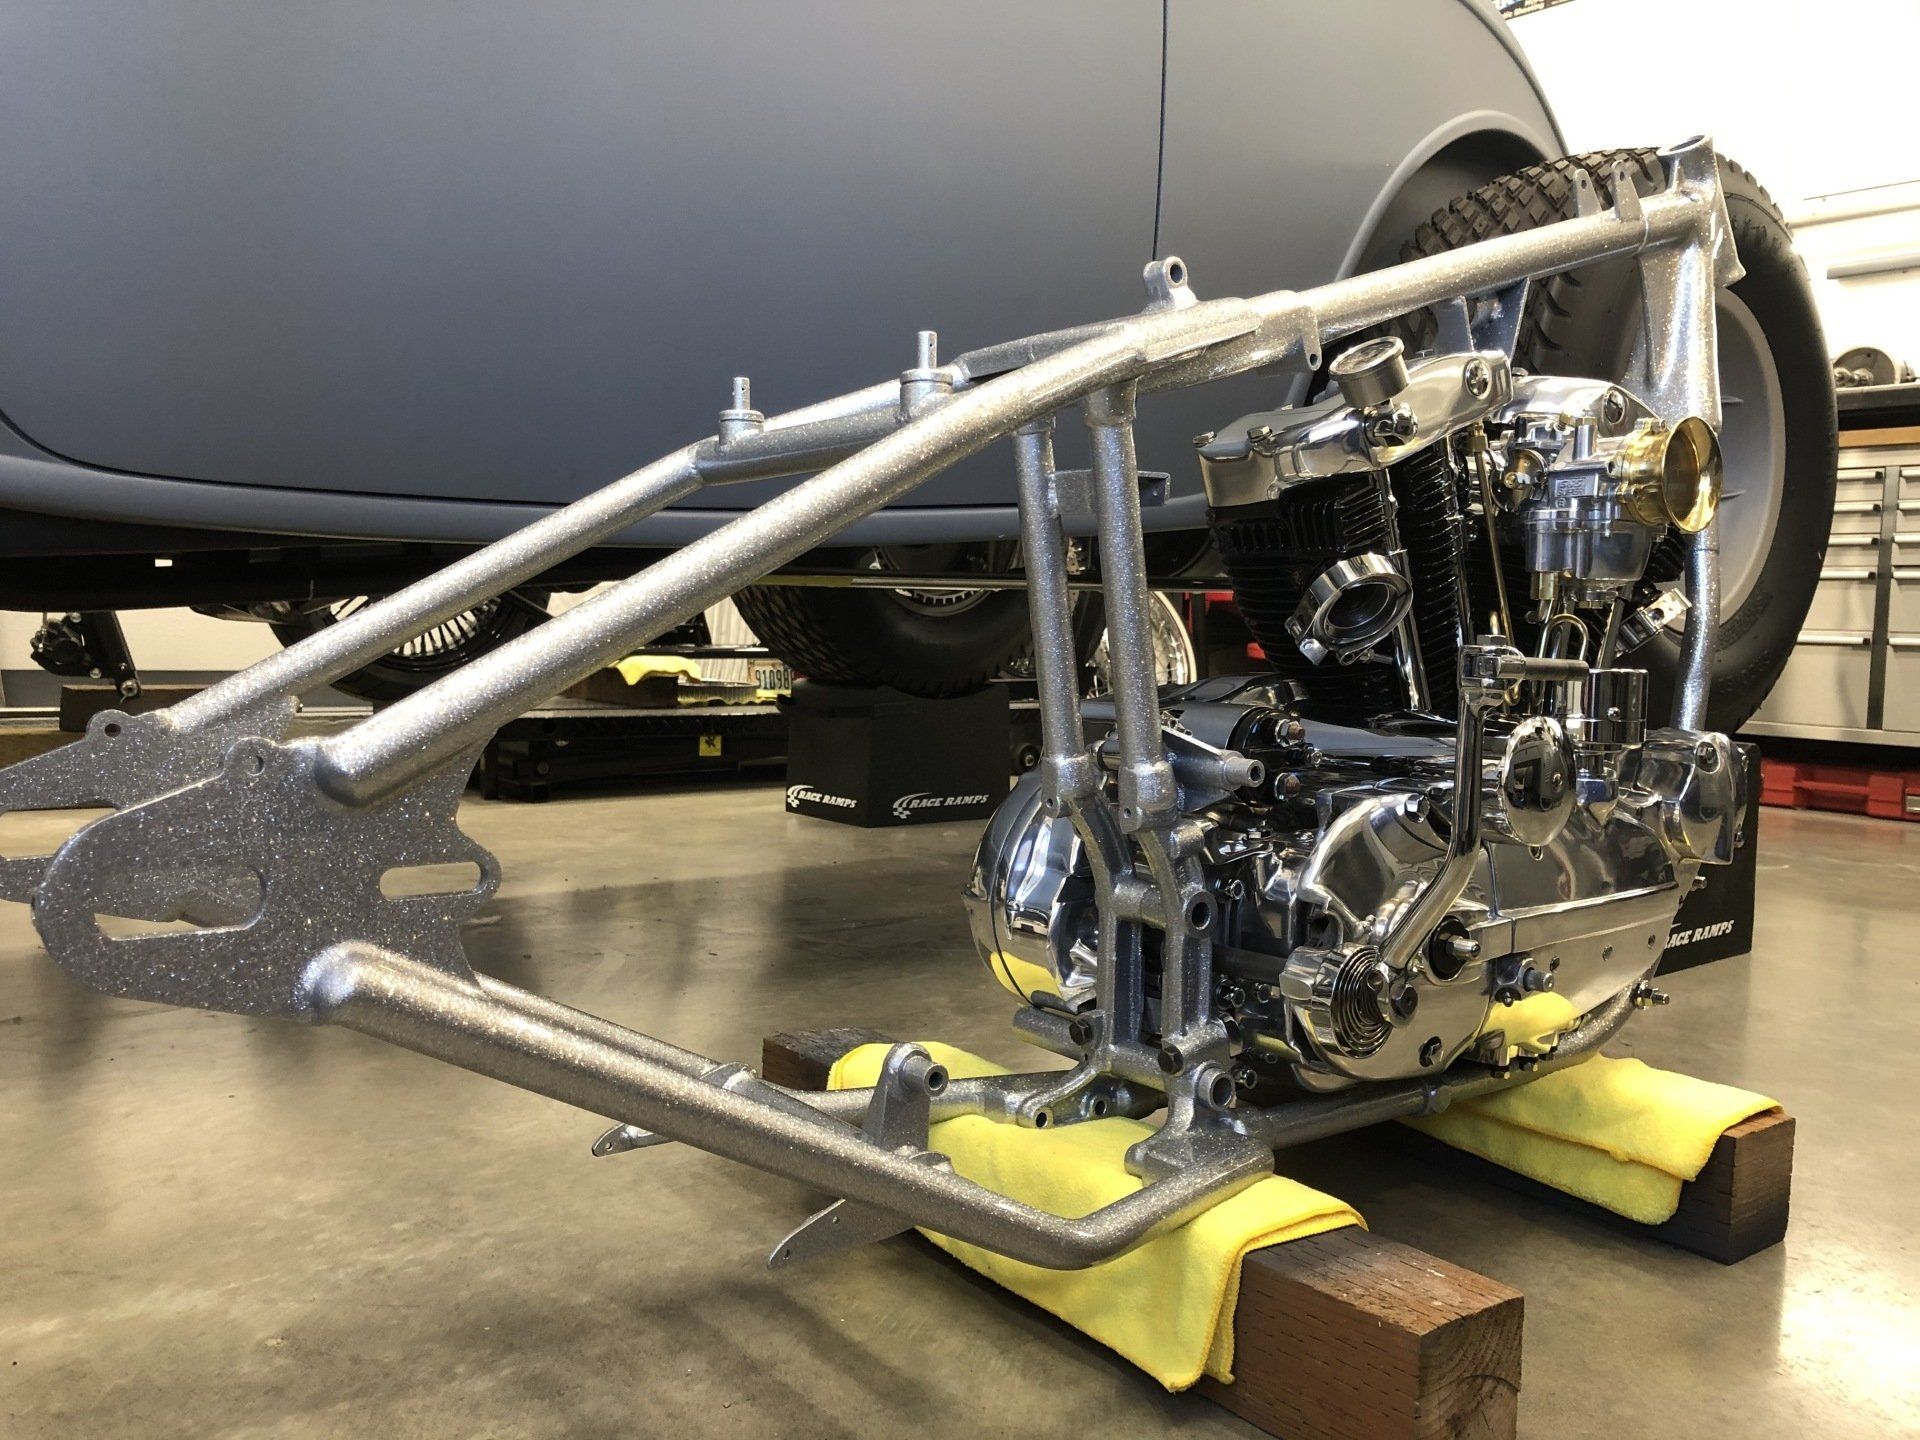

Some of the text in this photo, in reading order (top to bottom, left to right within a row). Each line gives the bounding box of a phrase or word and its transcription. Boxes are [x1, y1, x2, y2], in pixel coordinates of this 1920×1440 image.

[798, 790, 858, 809] RACE RAMPS
[908, 793, 990, 809] RACE RAMPS
[1692, 920, 1735, 942] RAMPS
